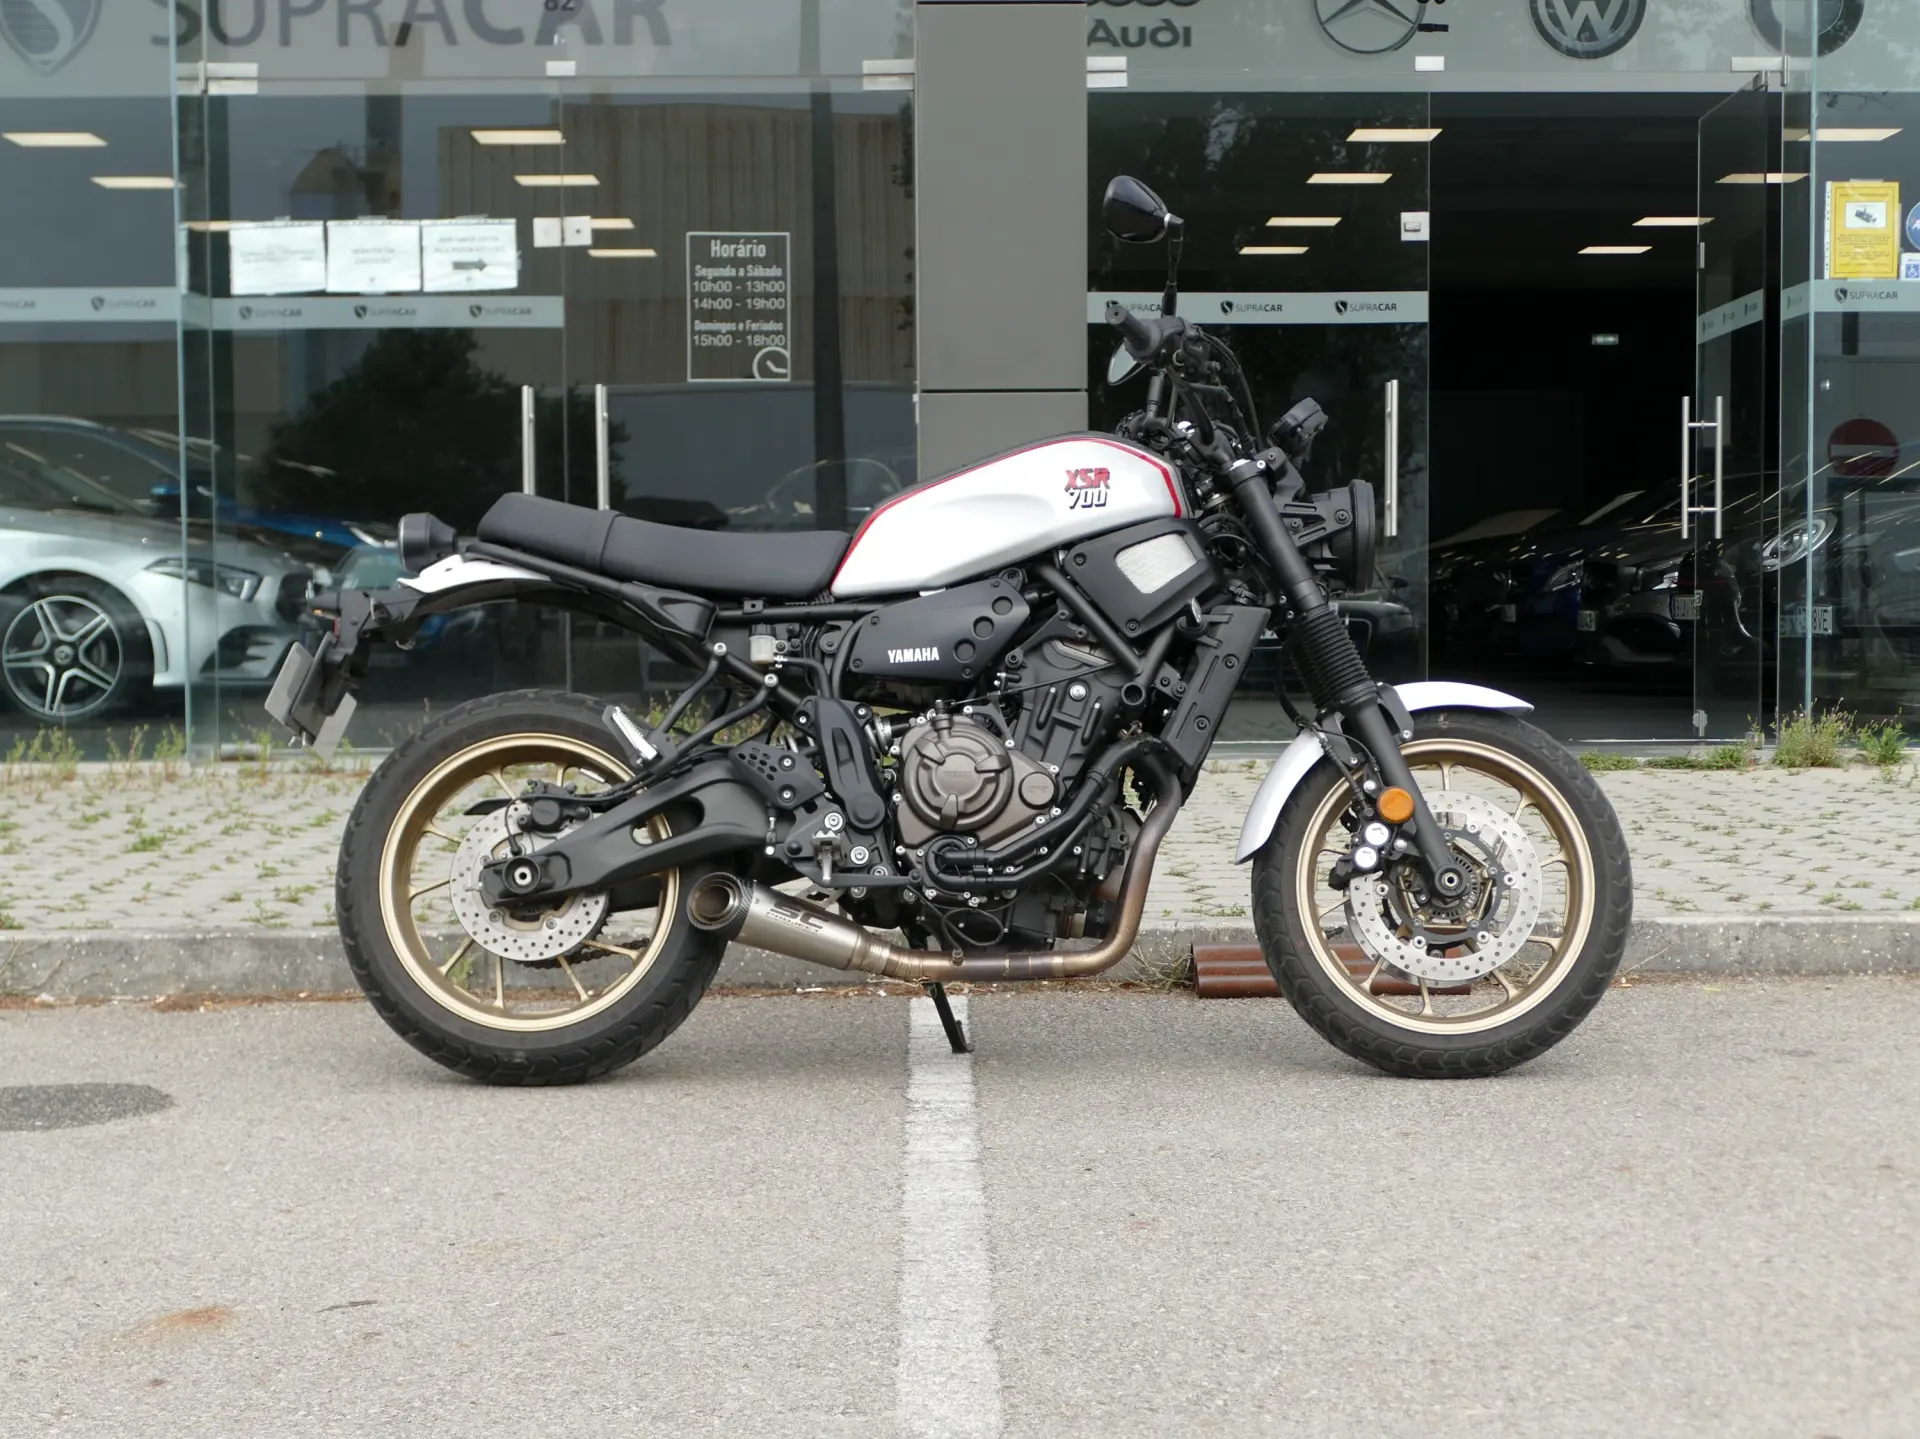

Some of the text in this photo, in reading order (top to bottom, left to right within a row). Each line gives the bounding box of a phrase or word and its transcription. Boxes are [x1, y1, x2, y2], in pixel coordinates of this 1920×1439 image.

[152, 0, 672, 46] SUPRACAR
[1086, 18, 1192, 48] Audi
[710, 238, 767, 258] Horário
[694, 264, 783, 279] Segunda a Sábado
[693, 280, 733, 293] 10h00
[745, 280, 785, 293] 13h00
[1850, 291, 1898, 300] SUPRACAR
[693, 298, 733, 310] 14h00
[745, 298, 785, 310] 19h00
[1235, 302, 1283, 313] SUPRACAR
[1350, 302, 1397, 312] SUPRACAR
[693, 334, 733, 347] 15h00
[745, 334, 785, 347] 18h00
[1064, 467, 1111, 492] XSR
[1068, 488, 1108, 510] 700
[887, 647, 940, 664] YAMAHA
